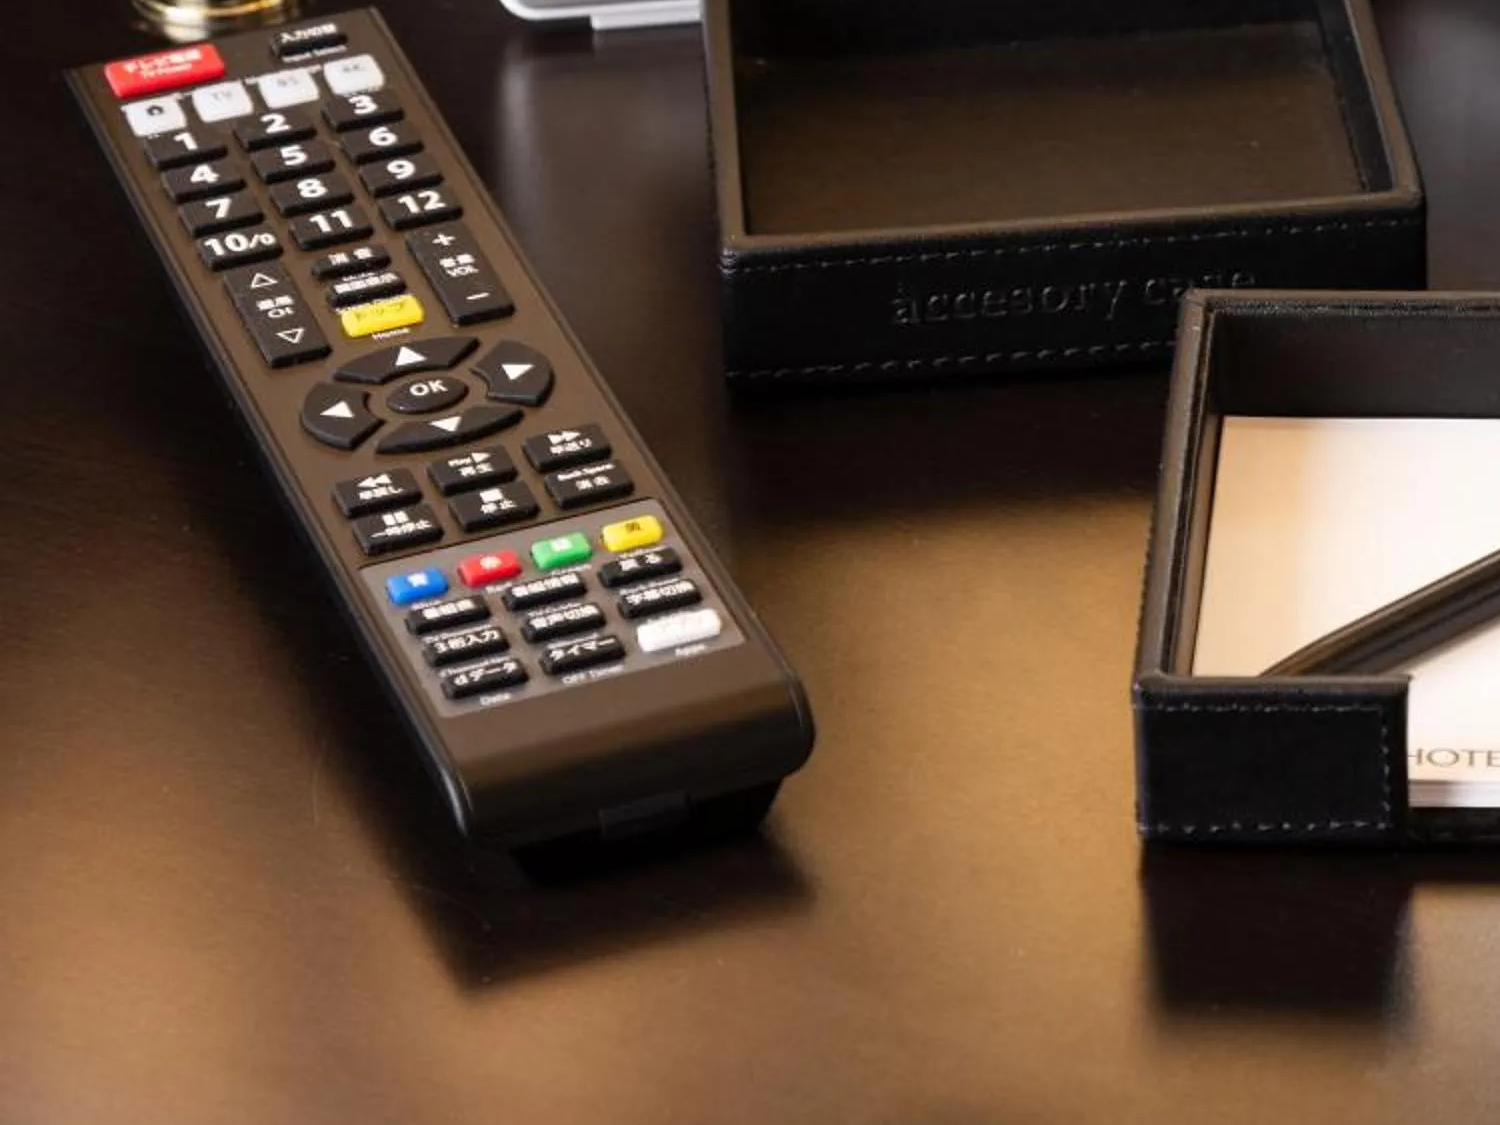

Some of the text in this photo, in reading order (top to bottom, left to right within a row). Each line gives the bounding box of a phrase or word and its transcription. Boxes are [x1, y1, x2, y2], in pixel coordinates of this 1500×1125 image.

[349, 95, 378, 115] 3
[260, 113, 291, 134] 2
[174, 132, 198, 151] 1
[368, 126, 398, 147] 6
[279, 145, 308, 166] 5
[189, 164, 220, 184] 4
[386, 159, 416, 180] 9
[296, 178, 328, 199] 8
[205, 198, 232, 219] 7
[397, 190, 447, 215] 12
[309, 209, 353, 233] 11
[409, 379, 448, 397] OK
